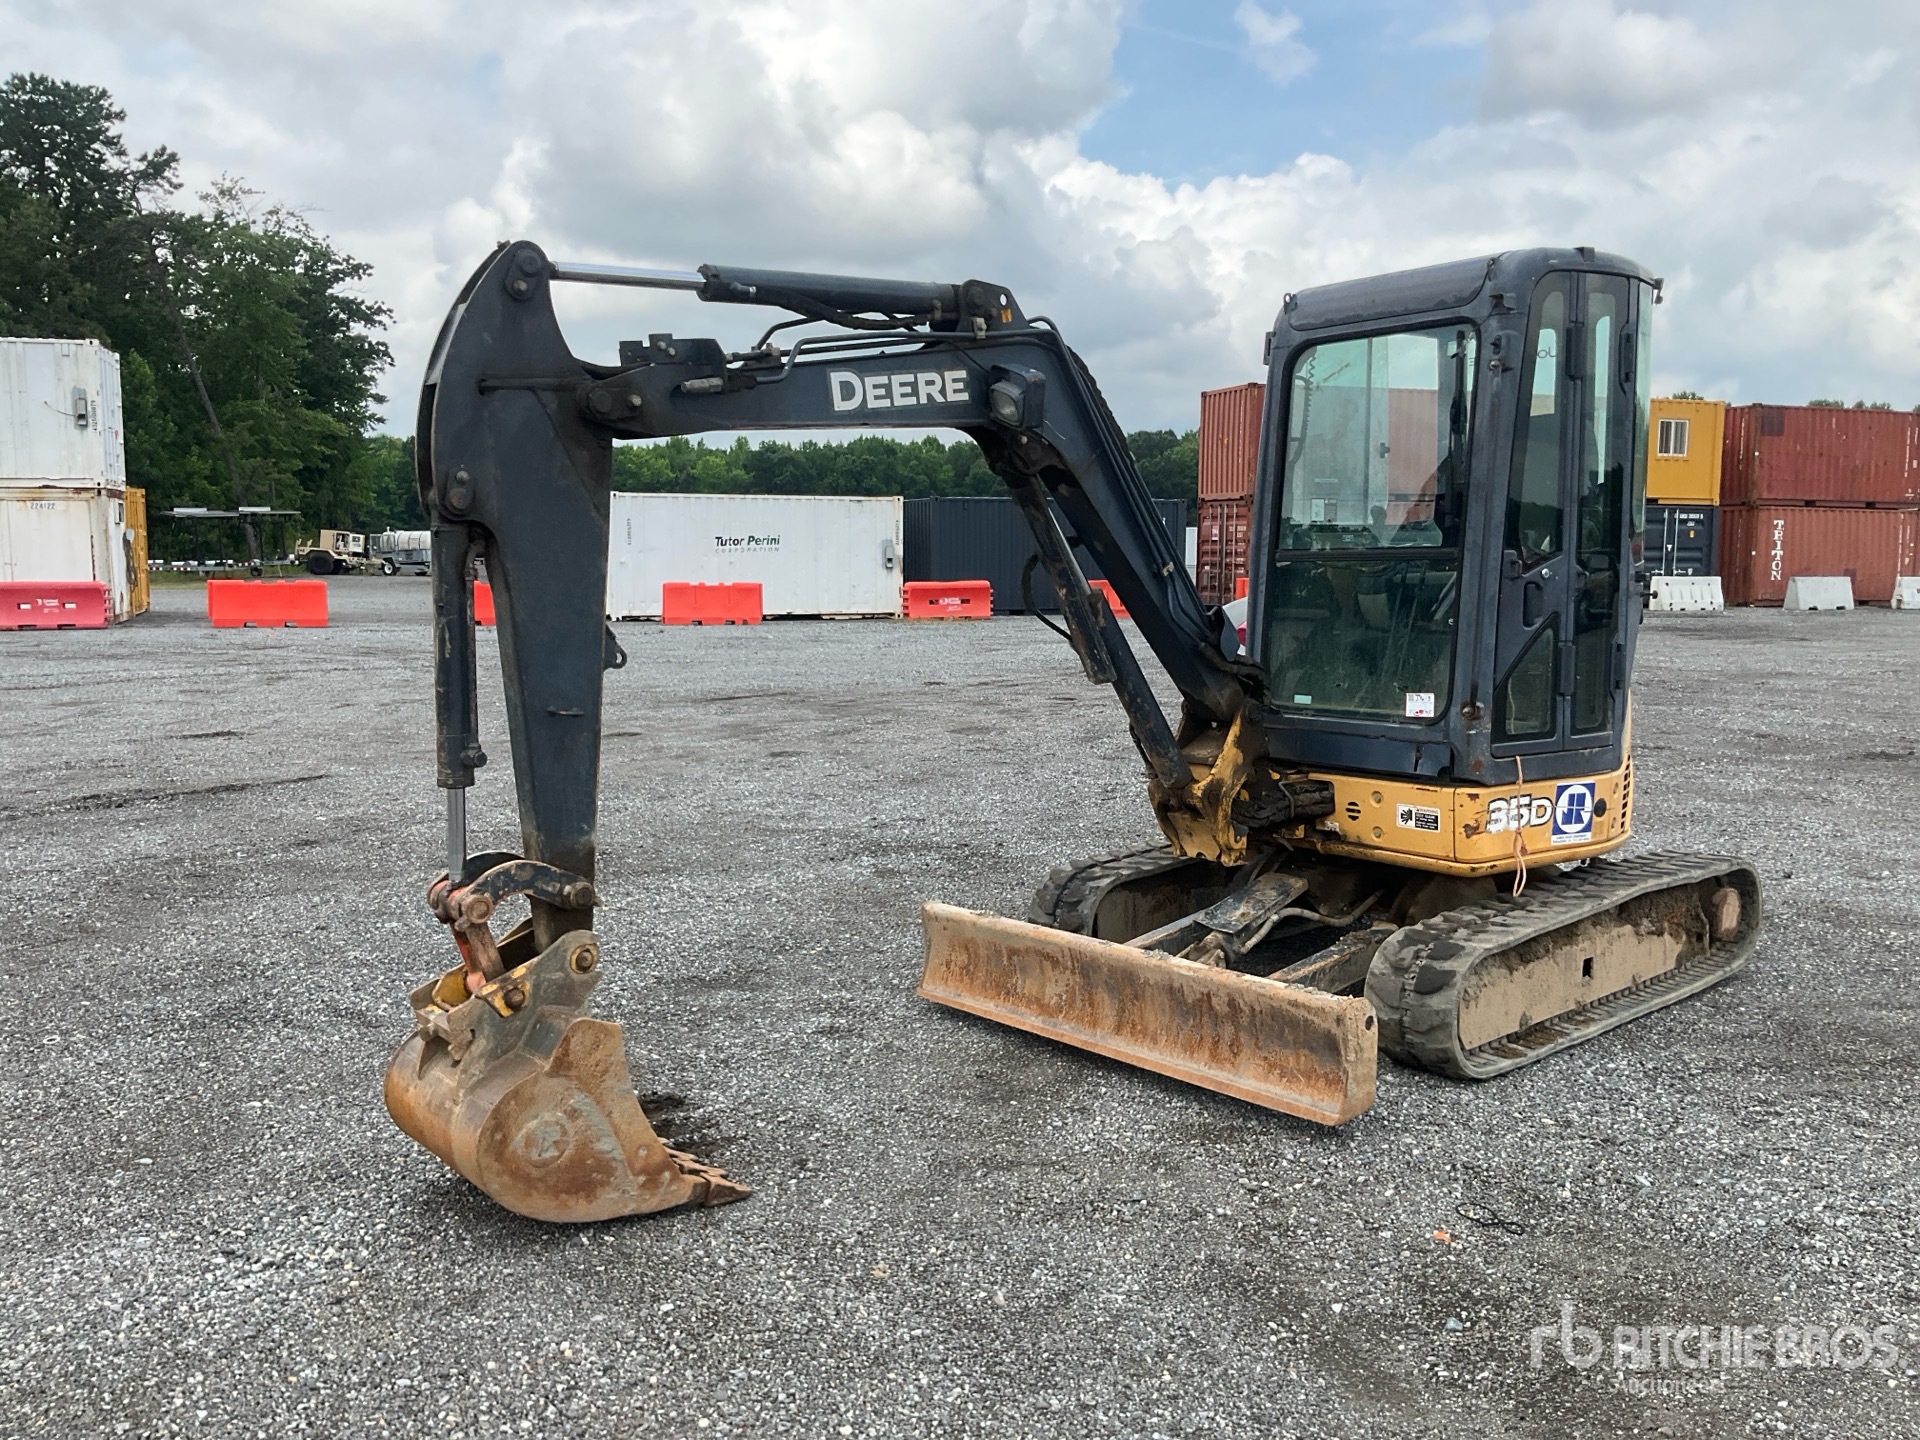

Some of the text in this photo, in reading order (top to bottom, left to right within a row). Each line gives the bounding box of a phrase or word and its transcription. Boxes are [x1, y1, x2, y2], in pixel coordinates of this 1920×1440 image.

[829, 370, 970, 411] DEERE
[715, 534, 780, 547] Tutor Perini
[1770, 519, 1785, 581] TRITON
[1485, 794, 1553, 833] 35D
